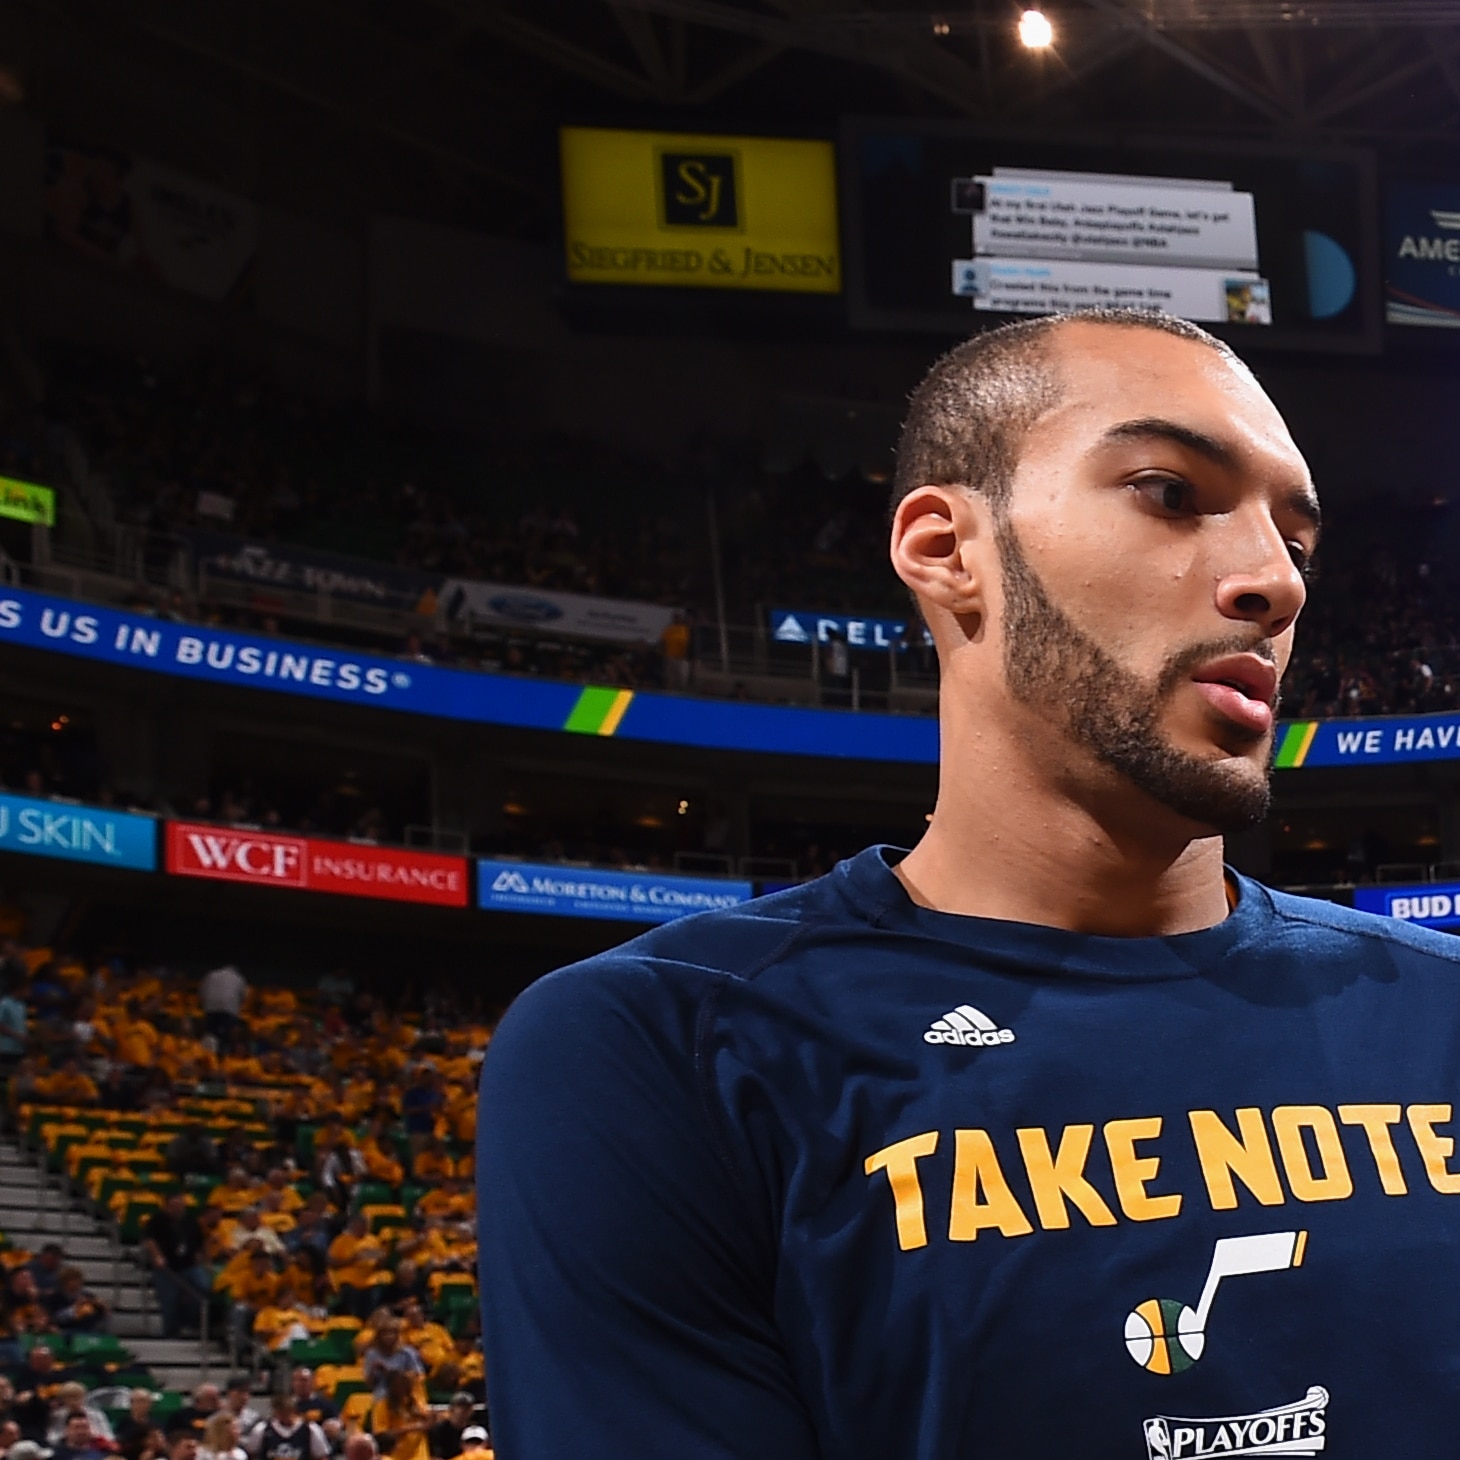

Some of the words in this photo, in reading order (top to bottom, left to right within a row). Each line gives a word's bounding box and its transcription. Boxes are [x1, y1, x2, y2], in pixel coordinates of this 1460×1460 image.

[741, 247, 834, 278] JENSEN
[39, 607, 101, 646] US
[114, 623, 162, 658] IN
[1336, 730, 1384, 755] WE
[16, 805, 118, 856] SKIN
[187, 832, 301, 881] WCF
[313, 854, 459, 894] INSURANCE
[630, 884, 646, 904] &
[1391, 893, 1452, 921] BUD
[924, 1024, 1016, 1048] adidas
[864, 1117, 1183, 1251] TAKE
[1172, 1409, 1327, 1459] PLAYOFFS
